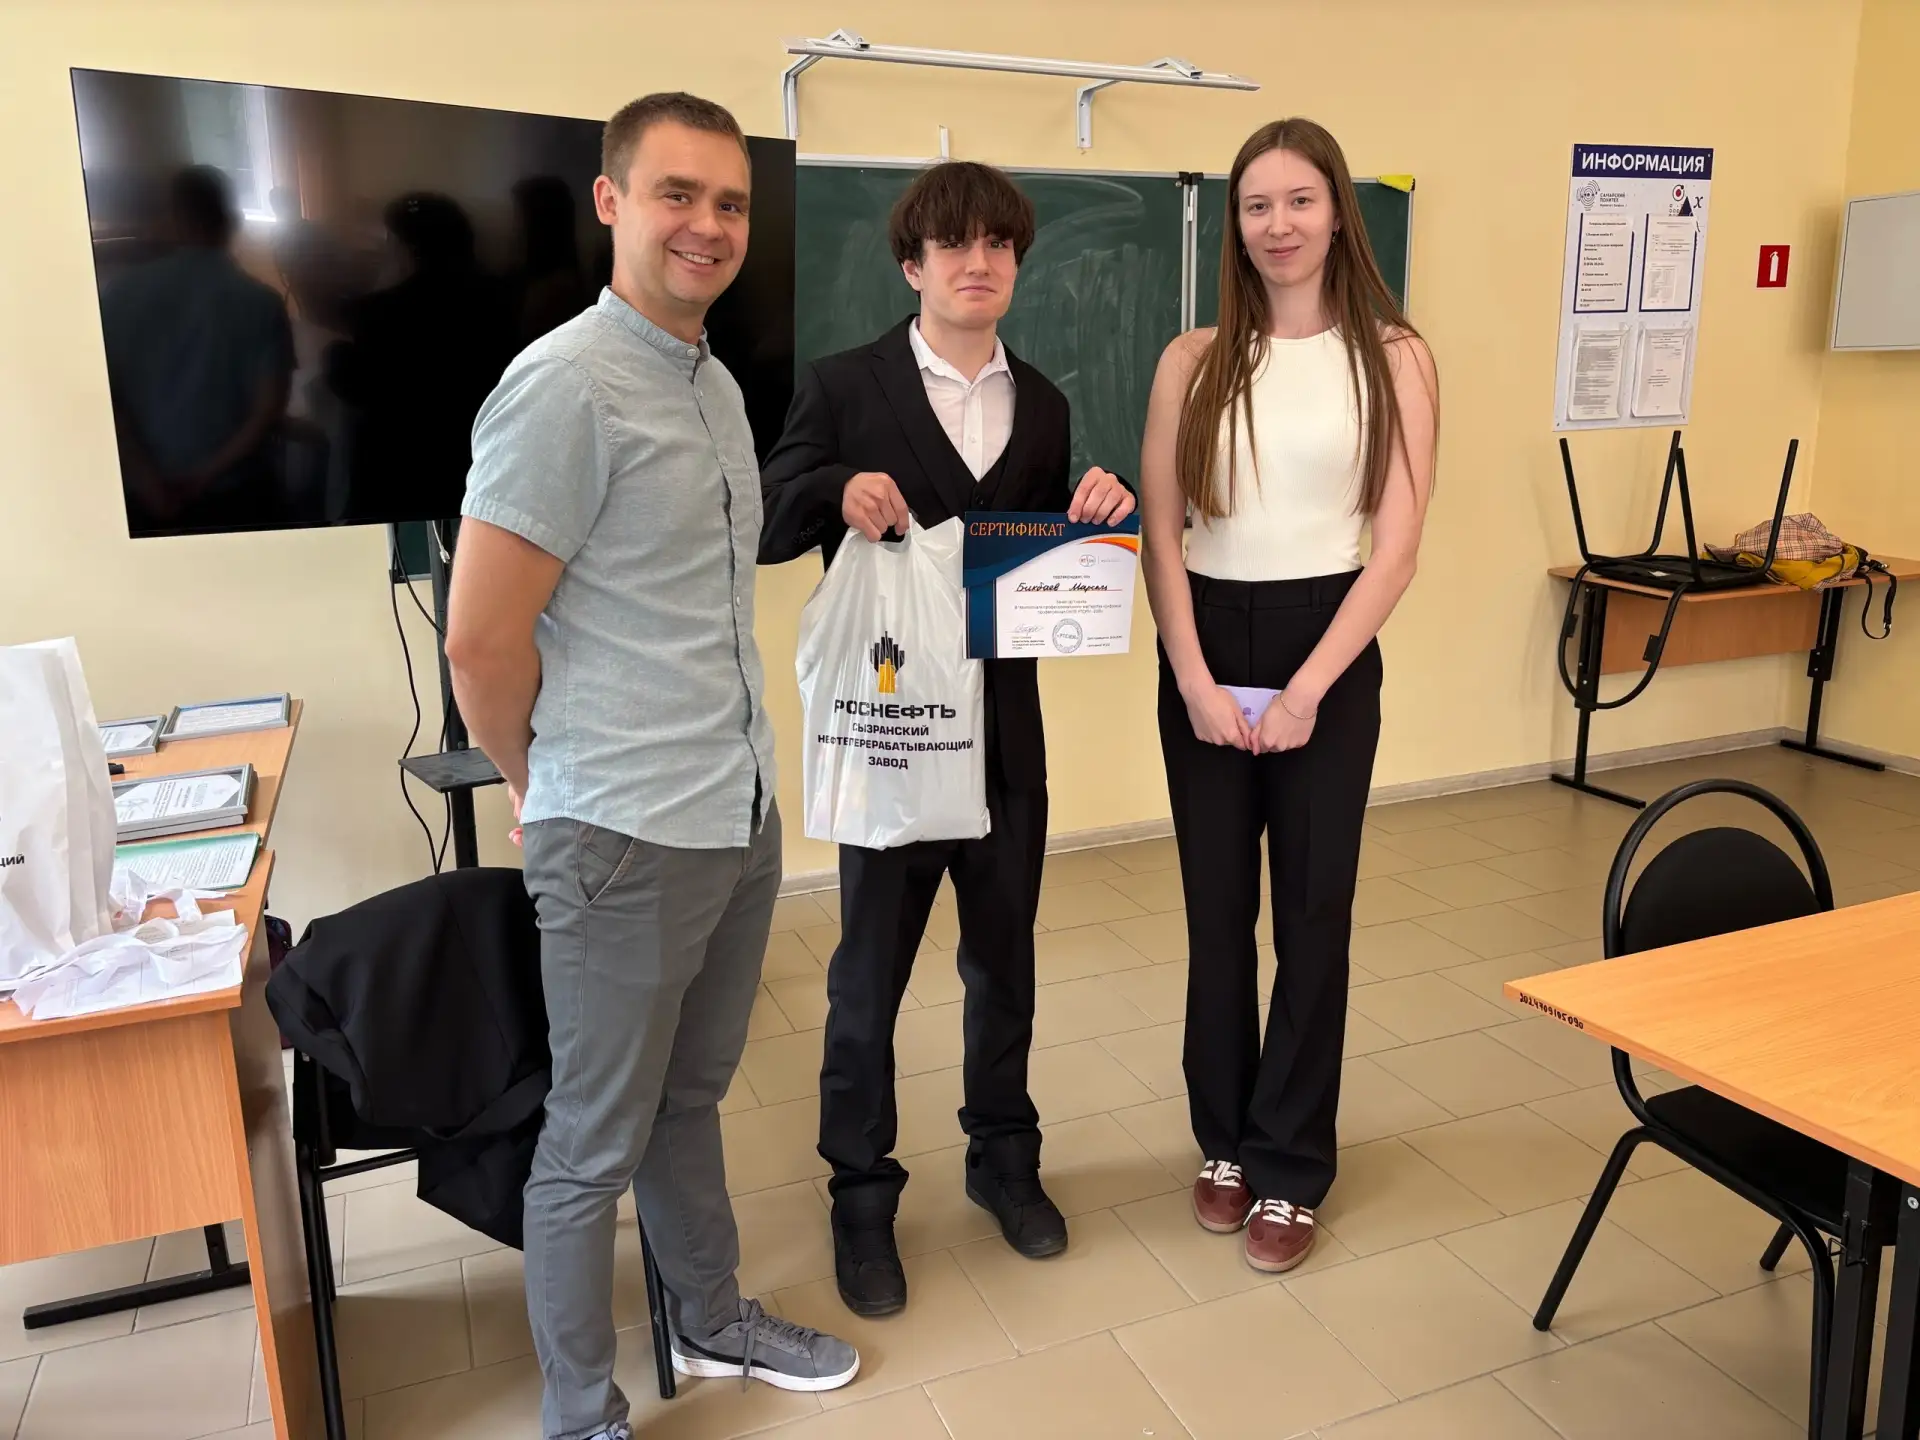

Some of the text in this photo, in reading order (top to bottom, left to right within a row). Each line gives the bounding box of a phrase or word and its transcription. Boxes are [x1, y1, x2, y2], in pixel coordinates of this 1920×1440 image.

[1582, 152, 1705, 175] ИНФОРМАЦИЯ
[970, 521, 1065, 537] СЕРТИФИКАТ
[834, 699, 957, 720] РОСНЕФТЬ
[852, 722, 930, 737] СЫЗРАНСКИЙ
[817, 734, 974, 752] НЕФТЕПЕРЕРАБАТЫВАЮЩИЙ
[868, 756, 909, 770] ЗАВОД
